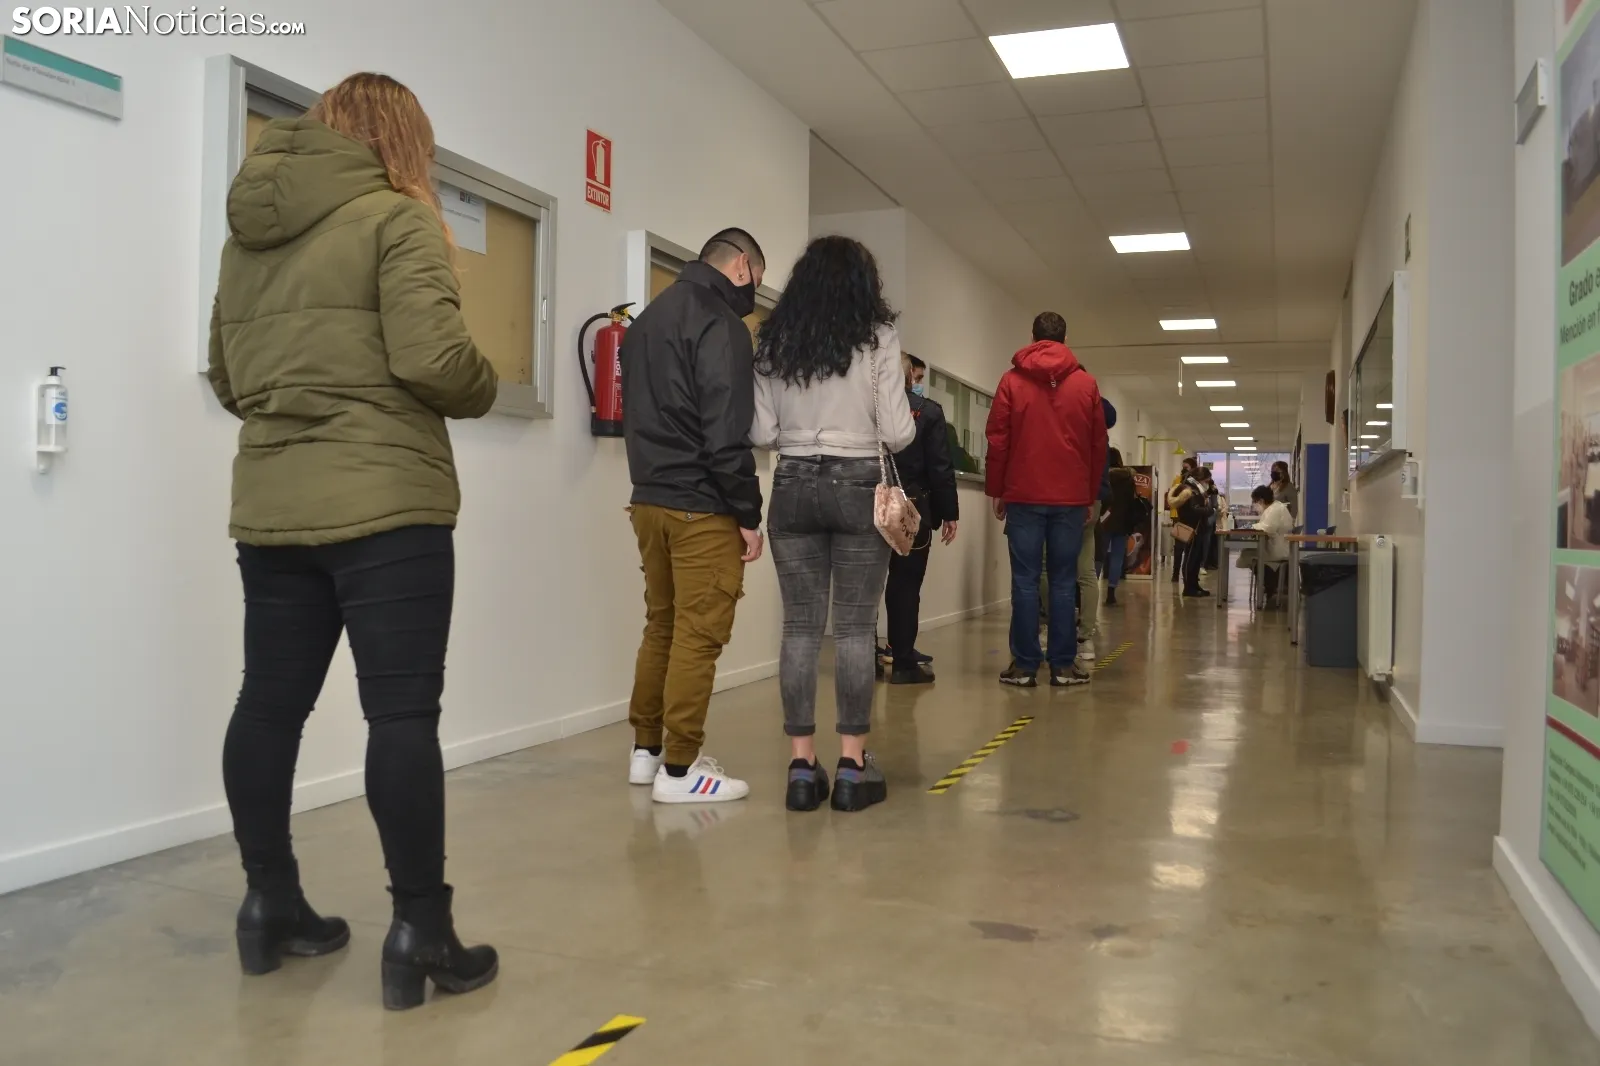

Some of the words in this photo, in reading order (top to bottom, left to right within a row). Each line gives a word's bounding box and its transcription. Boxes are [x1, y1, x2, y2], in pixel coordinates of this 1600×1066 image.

[587, 185, 610, 207] EXTINTOR
[1570, 270, 1593, 306] Grado
[1560, 315, 1586, 343] Mención
